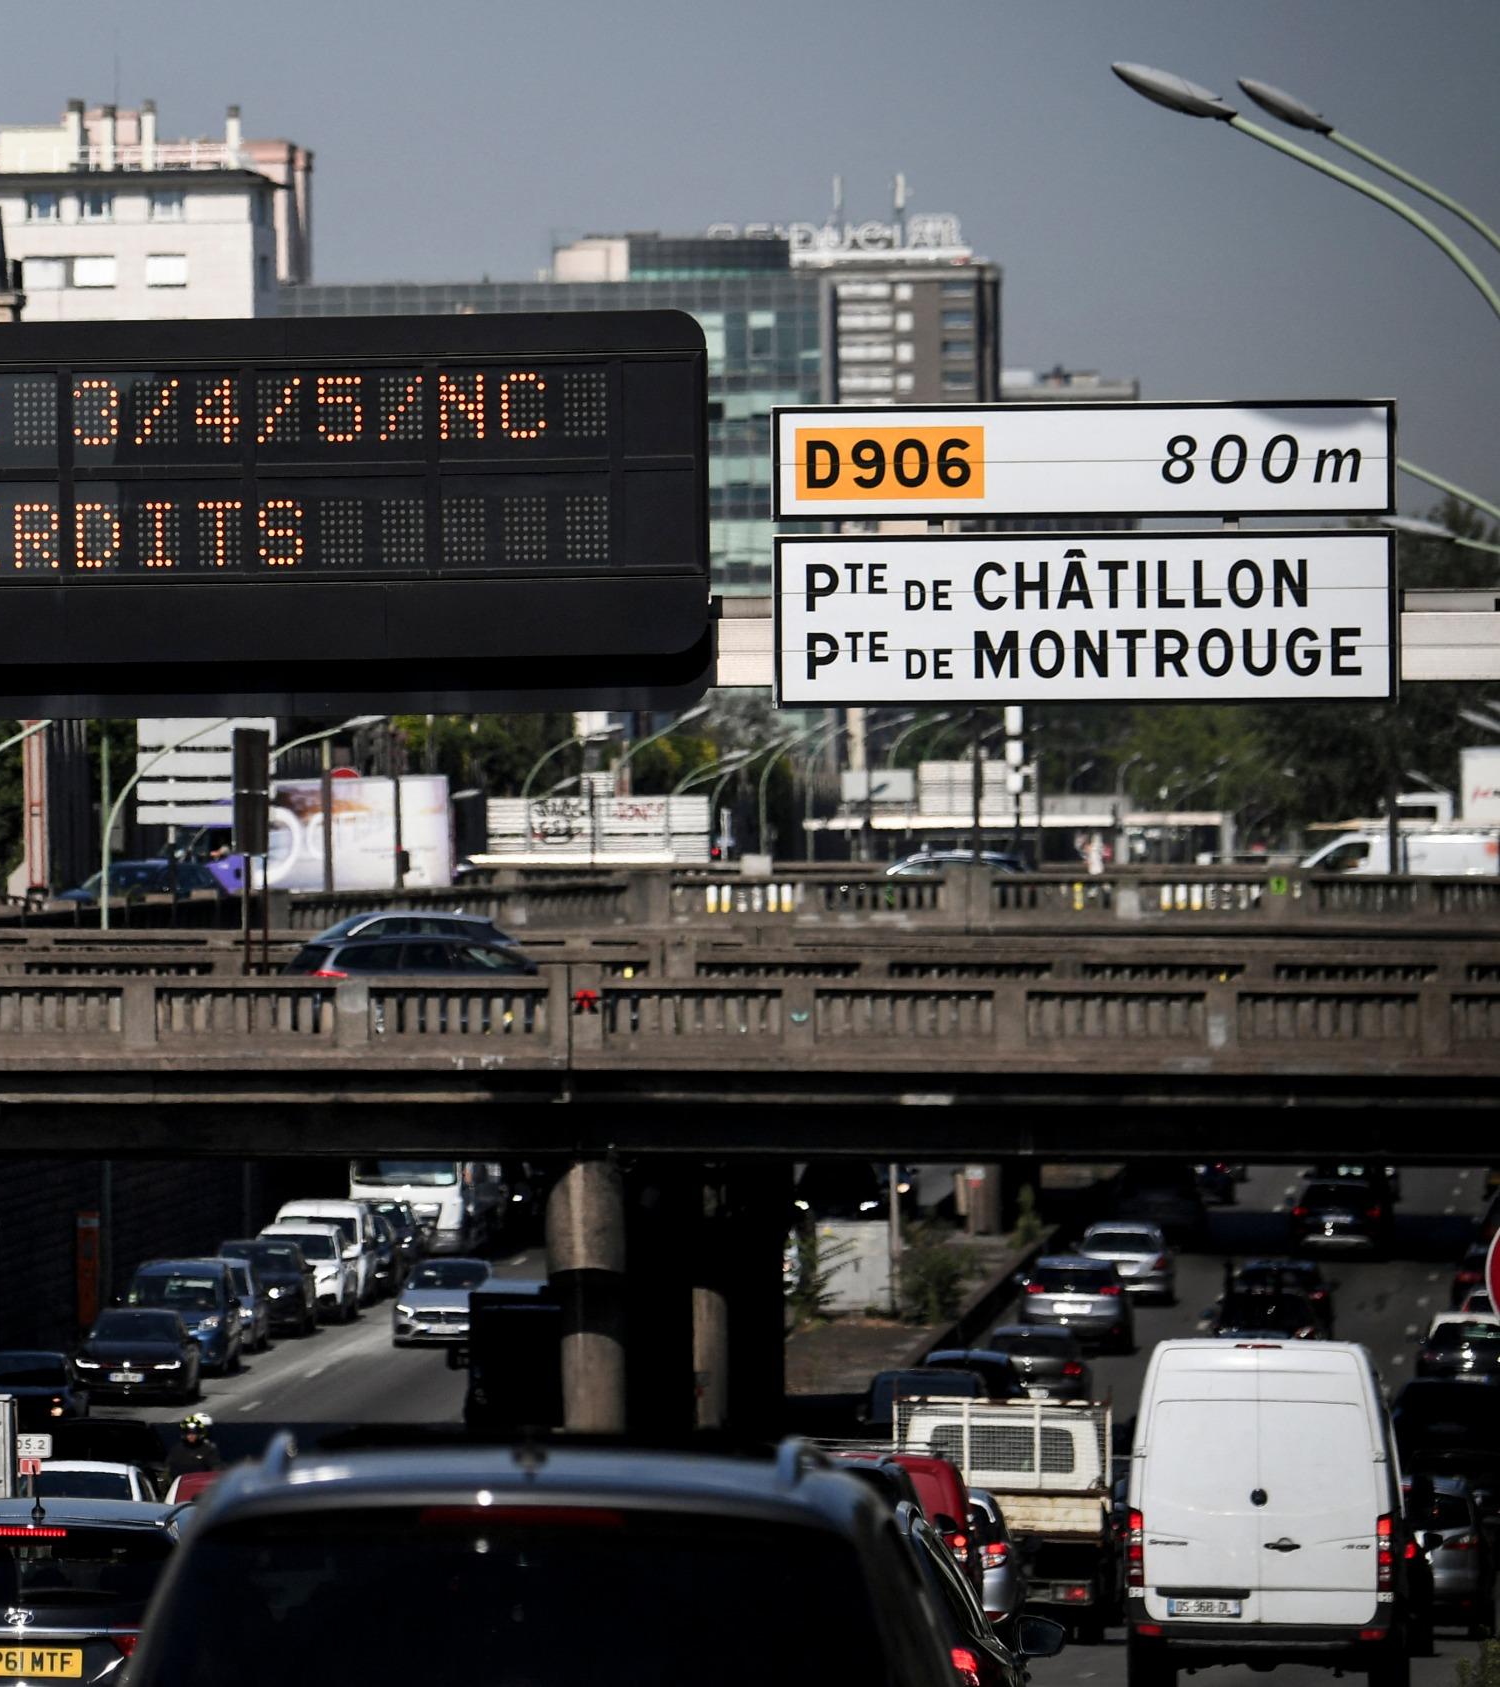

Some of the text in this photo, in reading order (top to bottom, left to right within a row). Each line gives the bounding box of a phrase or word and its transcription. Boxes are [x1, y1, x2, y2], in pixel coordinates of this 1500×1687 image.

[71, 371, 549, 446] 3/4/5/NC
[805, 438, 972, 490] D906
[904, 579, 953, 611] DE
[973, 548, 1308, 611] CHÂTILLON
[905, 648, 954, 680] DE
[973, 627, 1362, 679] MONTROUGE
[31, 1650, 73, 1673] MTF
